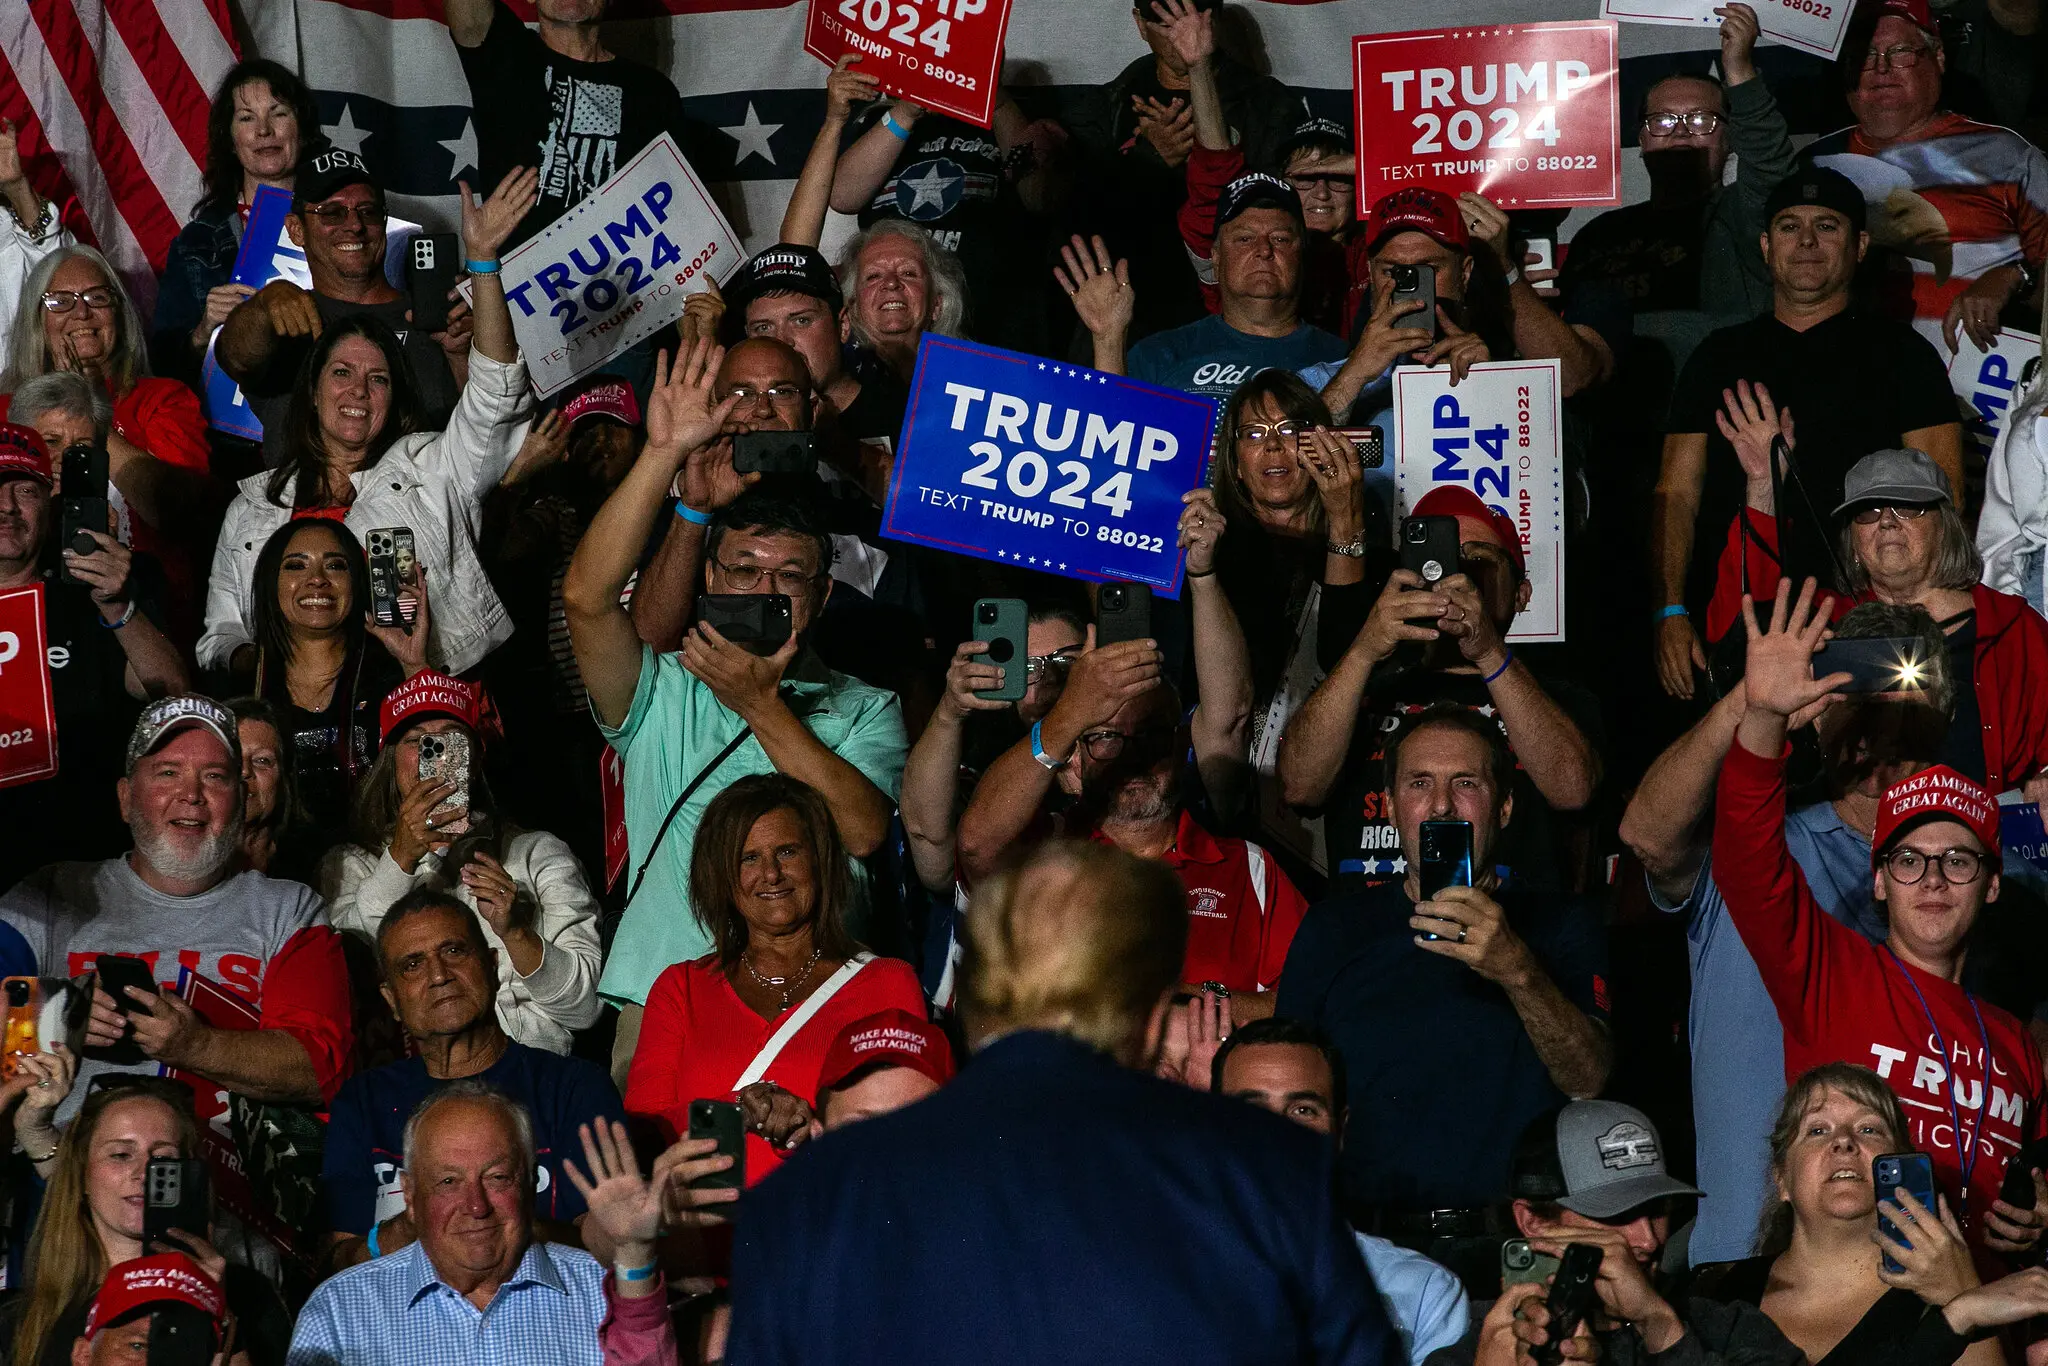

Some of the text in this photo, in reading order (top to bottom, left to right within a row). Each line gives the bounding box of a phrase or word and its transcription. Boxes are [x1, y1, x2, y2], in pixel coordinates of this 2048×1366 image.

[839, 0, 951, 58] 2024
[821, 11, 977, 91] TEXT TRUMP TO 88022
[1381, 60, 1591, 111] TRUMP
[1412, 105, 1561, 155] 2024
[312, 150, 370, 175] USA
[1380, 155, 1598, 180] TEXT TRUMP TO 88022
[505, 181, 673, 317] TRUMP
[753, 252, 808, 272] Trump
[550, 231, 682, 335] 2024
[540, 241, 719, 366] TEXT TRUMP TO 88022
[1193, 363, 1251, 385] Old
[945, 382, 1179, 472] TRUMP
[1518, 386, 1530, 448] 88022
[961, 441, 1133, 518] 2024
[1474, 424, 1510, 518] 24
[1518, 456, 1531, 481] TO
[918, 486, 1164, 553] TEXT TRUMP TO 88022
[386, 675, 473, 704] MAKE AMERICA
[392, 691, 467, 716] GREAT AGAIN
[150, 698, 228, 725] TRUMP
[0, 728, 34, 748] 022
[1886, 774, 1995, 811] MAKE AMERICA
[1892, 792, 1987, 824] GREAT AGAIN
[849, 1028, 929, 1047] MAKE AMERICA
[853, 1039, 922, 1055] GREAT AGAIN
[1870, 1043, 2030, 1128] TRUM
[123, 1268, 166, 1281] MAKE
[126, 1278, 176, 1291] GREAT
